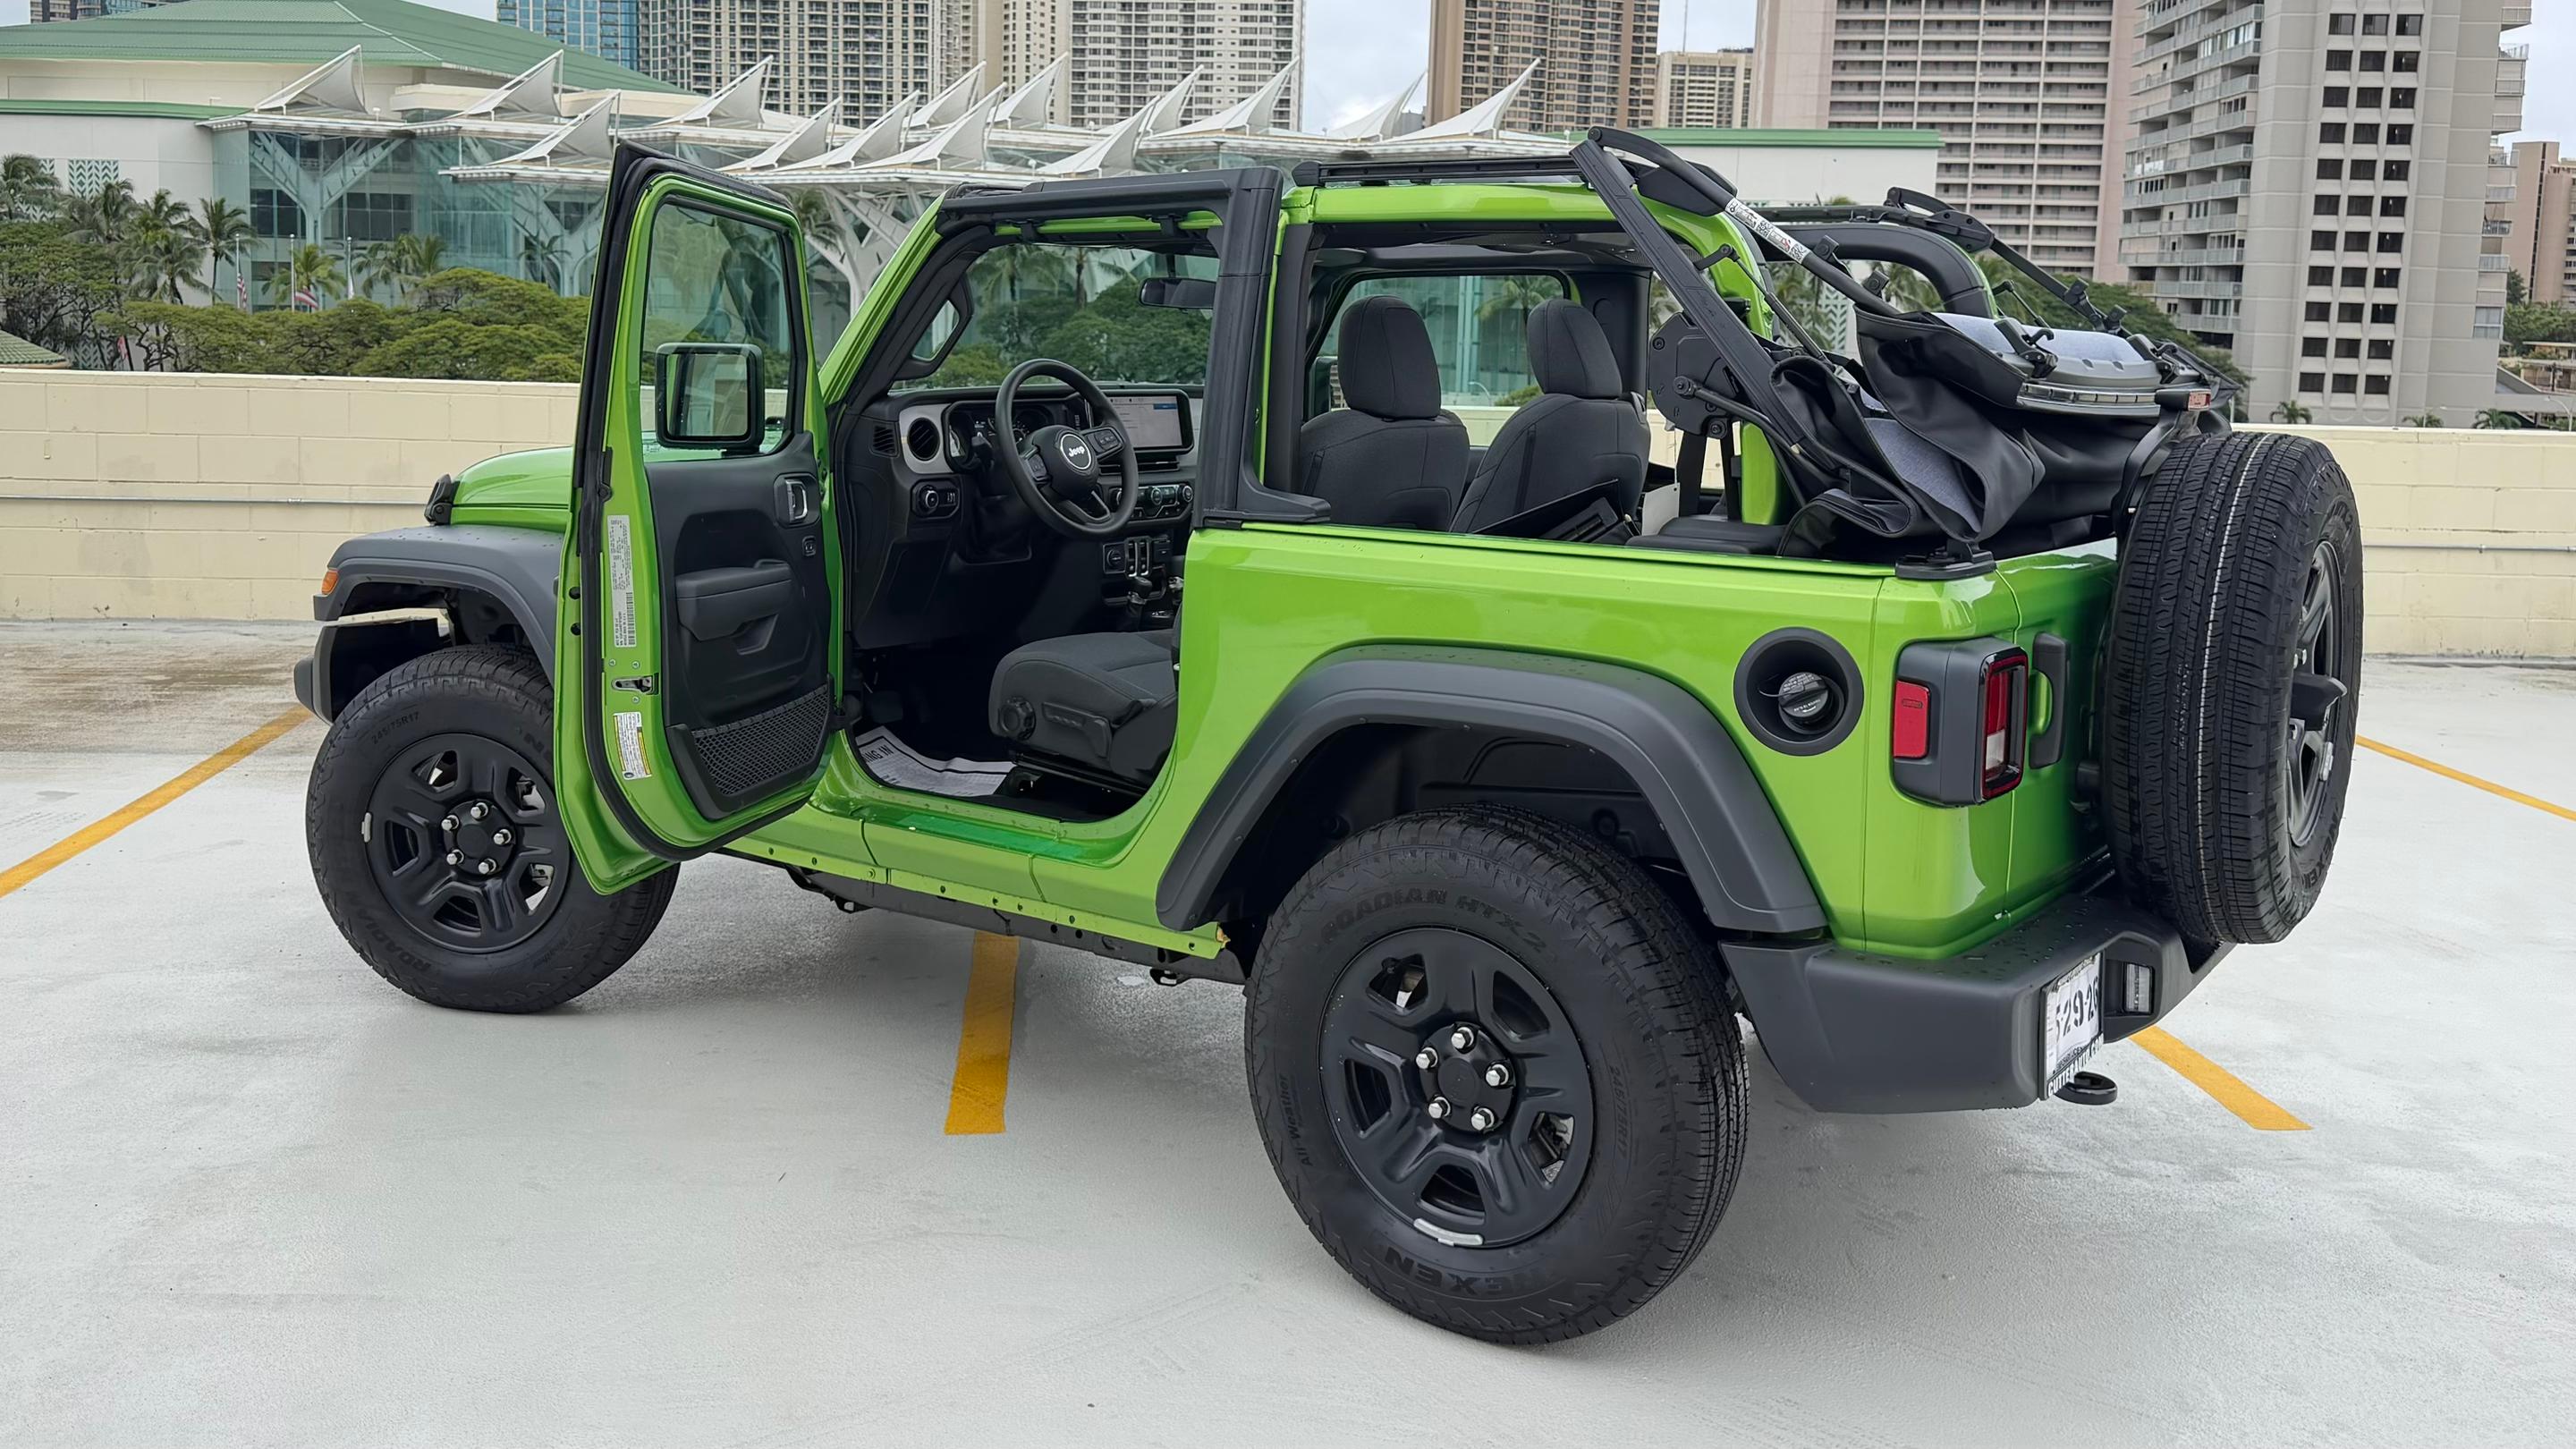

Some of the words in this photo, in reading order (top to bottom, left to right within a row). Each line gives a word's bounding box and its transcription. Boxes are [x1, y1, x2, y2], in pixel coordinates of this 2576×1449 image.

[1068, 445, 1086, 457] Jeep
[1318, 887, 1447, 945] ROADIAN
[1453, 894, 1546, 953] HTX2
[1279, 1072, 1314, 1167] All-Weather
[1609, 1064, 1628, 1158] 245/75R17
[1384, 1246, 1541, 1295] NEXEN
